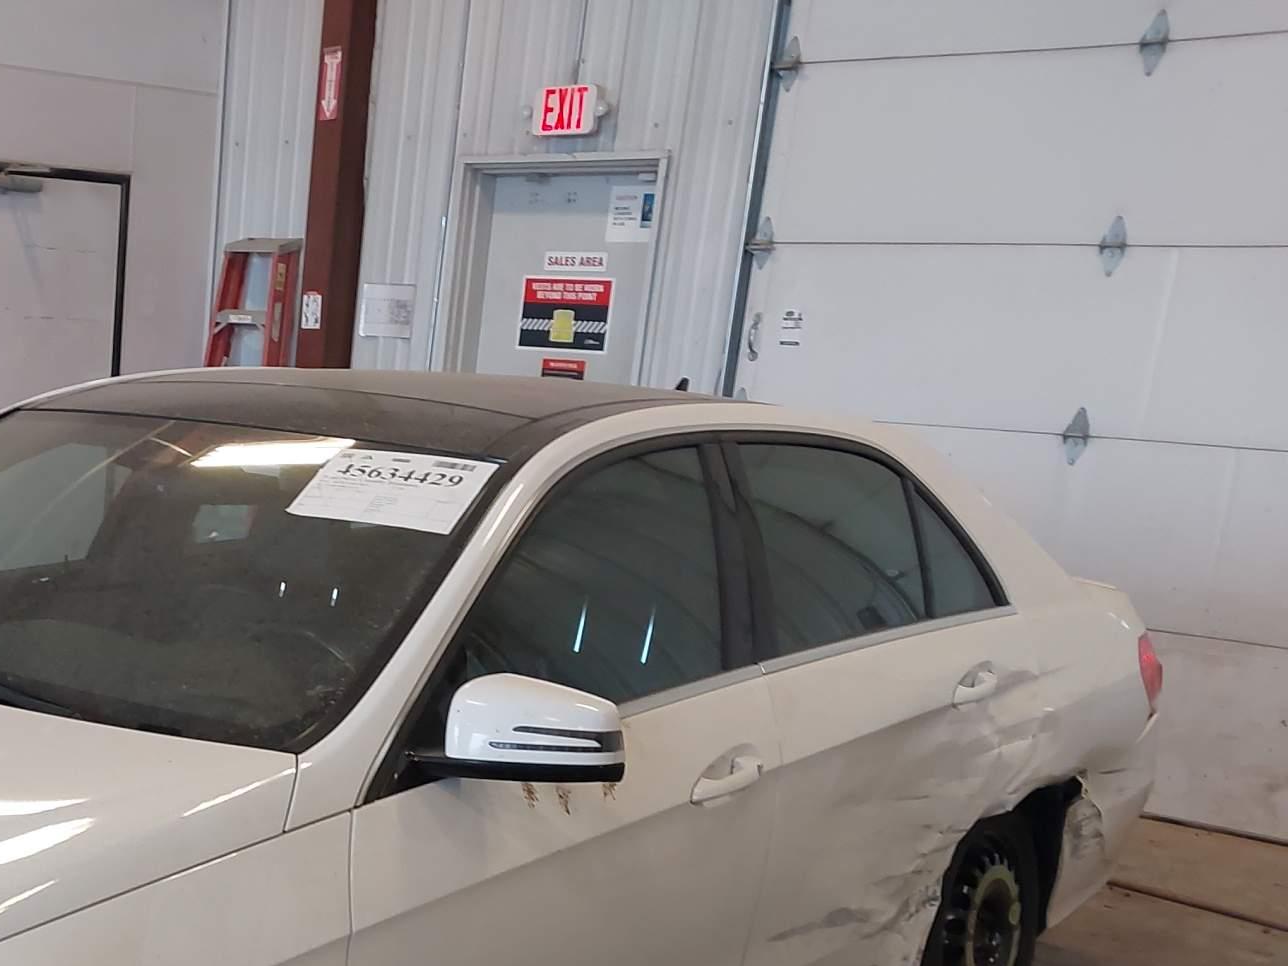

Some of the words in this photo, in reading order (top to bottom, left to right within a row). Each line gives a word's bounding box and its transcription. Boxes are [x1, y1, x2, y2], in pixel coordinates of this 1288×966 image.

[541, 86, 588, 132] EXIT
[547, 255, 577, 267] SALES
[579, 256, 604, 268] AREA
[337, 463, 464, 488] 45634429
